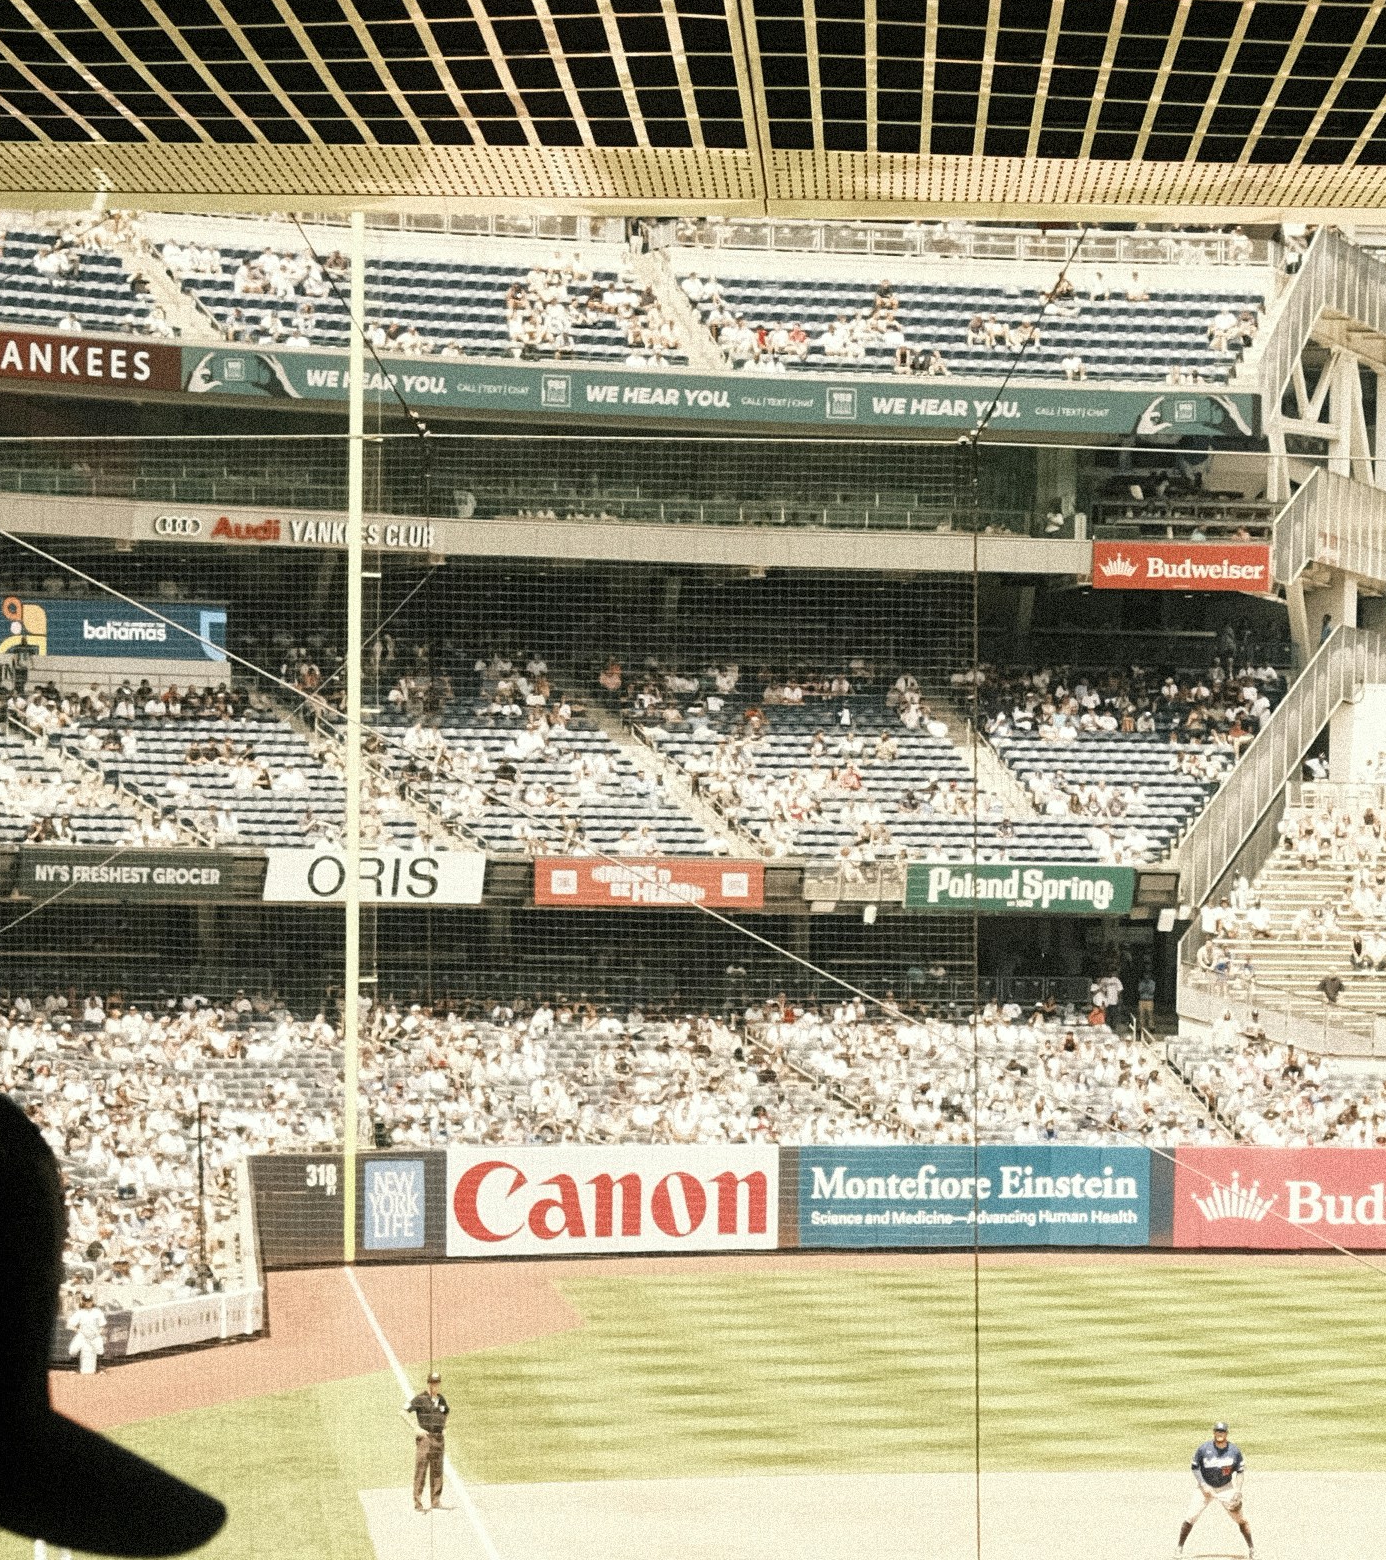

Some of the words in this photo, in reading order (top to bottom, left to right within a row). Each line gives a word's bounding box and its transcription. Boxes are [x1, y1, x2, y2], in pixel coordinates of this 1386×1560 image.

[307, 369, 339, 388] WE
[402, 375, 448, 394] YOU.
[586, 385, 619, 403] WE
[622, 387, 679, 407] HEAR
[685, 389, 731, 408] YOU.
[872, 397, 906, 415] WE
[910, 398, 968, 417] HEAR
[974, 399, 1021, 419] YOU.
[212, 515, 282, 541] Audi
[290, 520, 380, 545] YANKS
[385, 524, 435, 548] CLUB
[1146, 556, 1265, 579] Budweiser
[83, 619, 167, 642] bahamas
[35, 864, 70, 882] NY'S
[72, 865, 150, 883] FRESHEST
[153, 867, 220, 885] GROCER
[307, 855, 439, 898] ORIS
[927, 867, 1020, 903] Poland
[1022, 869, 1114, 909] Spring
[306, 1163, 337, 1187] 318
[373, 1170, 416, 1195] NEW
[811, 1164, 991, 1200] Montefiore
[998, 1165, 1138, 1199] Einstein
[369, 1192, 421, 1216] YORK
[453, 1160, 767, 1243] Canon
[373, 1214, 415, 1238] LIFE
[811, 1210, 862, 1225] Science
[865, 1211, 890, 1225] and
[1038, 1209, 1088, 1224] Human
[1091, 1209, 1138, 1224] Health
